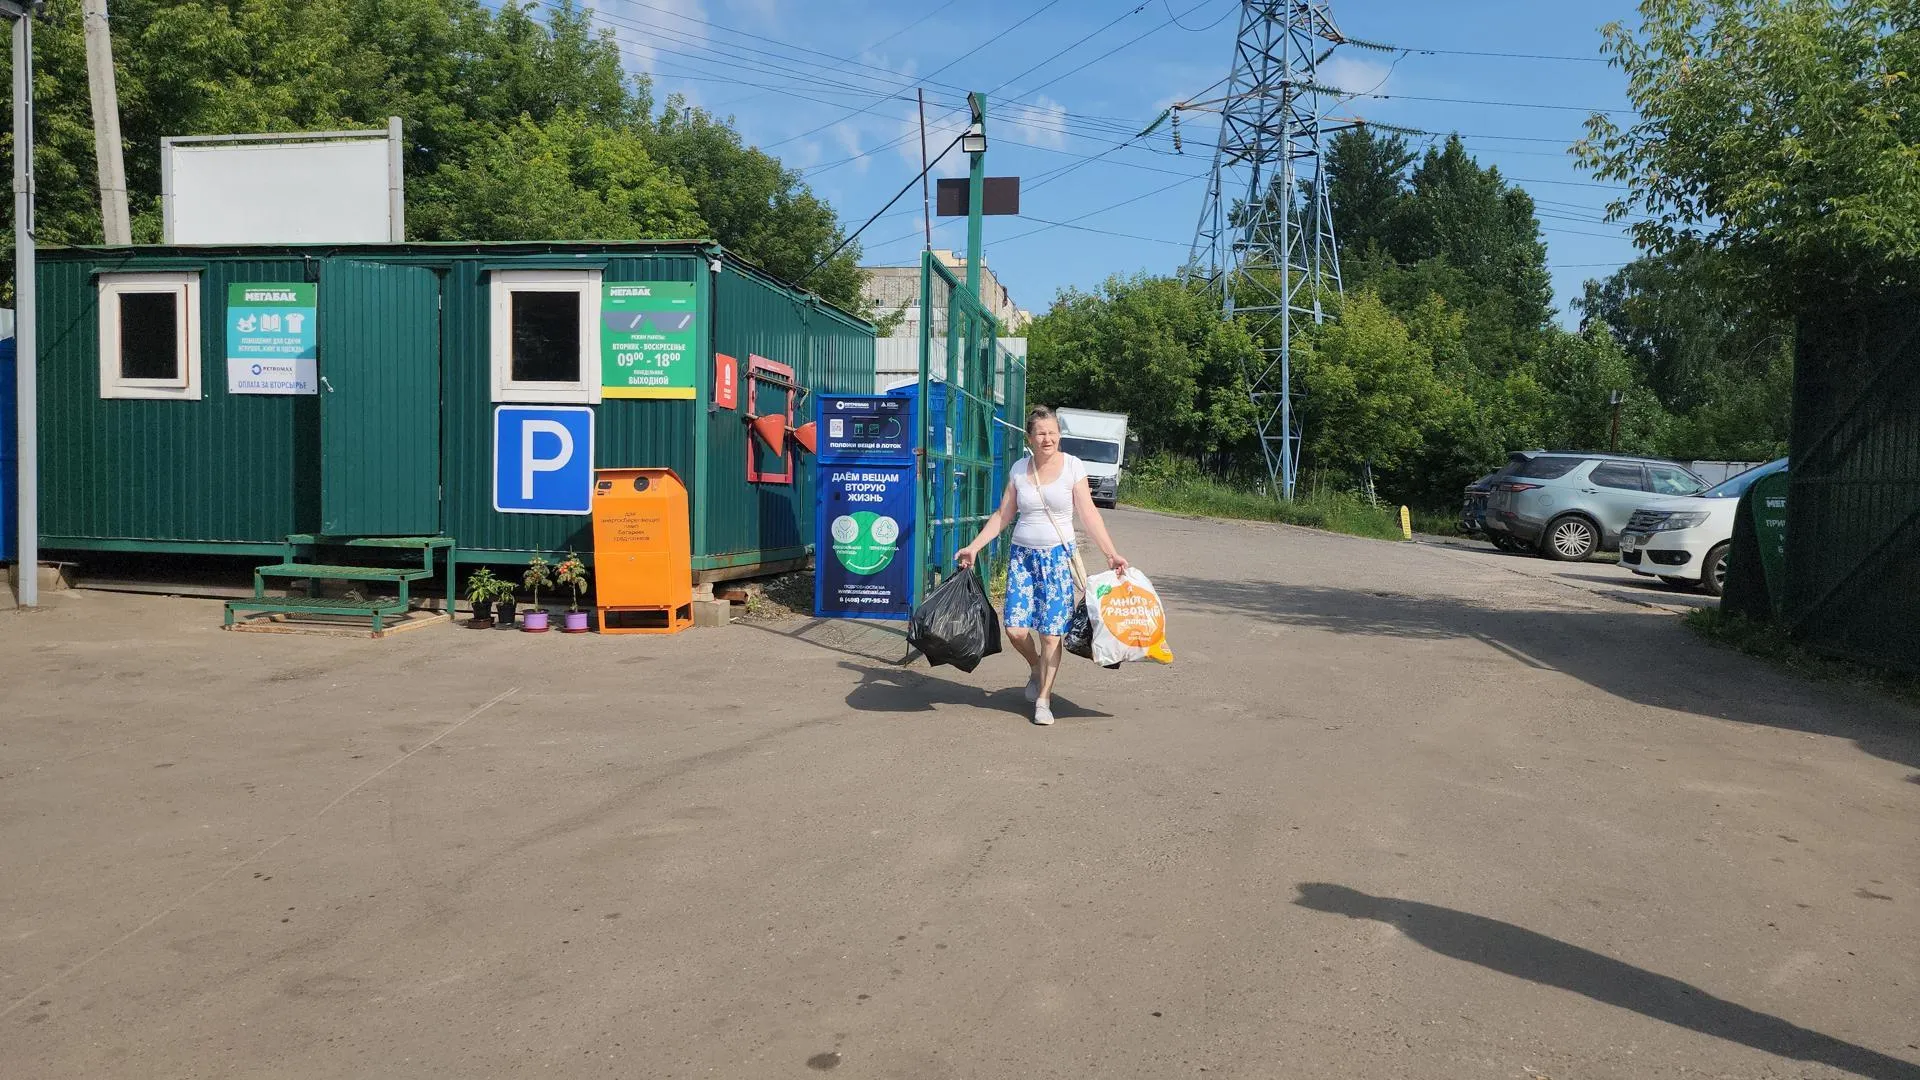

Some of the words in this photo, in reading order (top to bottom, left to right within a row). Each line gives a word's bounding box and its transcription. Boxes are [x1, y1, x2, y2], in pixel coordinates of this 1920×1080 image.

[244, 292, 297, 301] МЕГАБАК
[609, 288, 651, 296] МЕГАБАК
[612, 343, 639, 351] ВТОРНИК
[628, 375, 669, 385] ВЫХОДНОЙ
[270, 381, 307, 389] ВТОРСЫРЬЕ
[522, 420, 574, 500] P
[831, 471, 860, 482] ДАЁМ
[862, 473, 899, 483] ВЕЩАМ
[845, 483, 886, 492] ВТОРУЮ
[847, 493, 884, 502] ЖИЗНЬ
[1105, 605, 1161, 616] РАЗОВЫЙ
